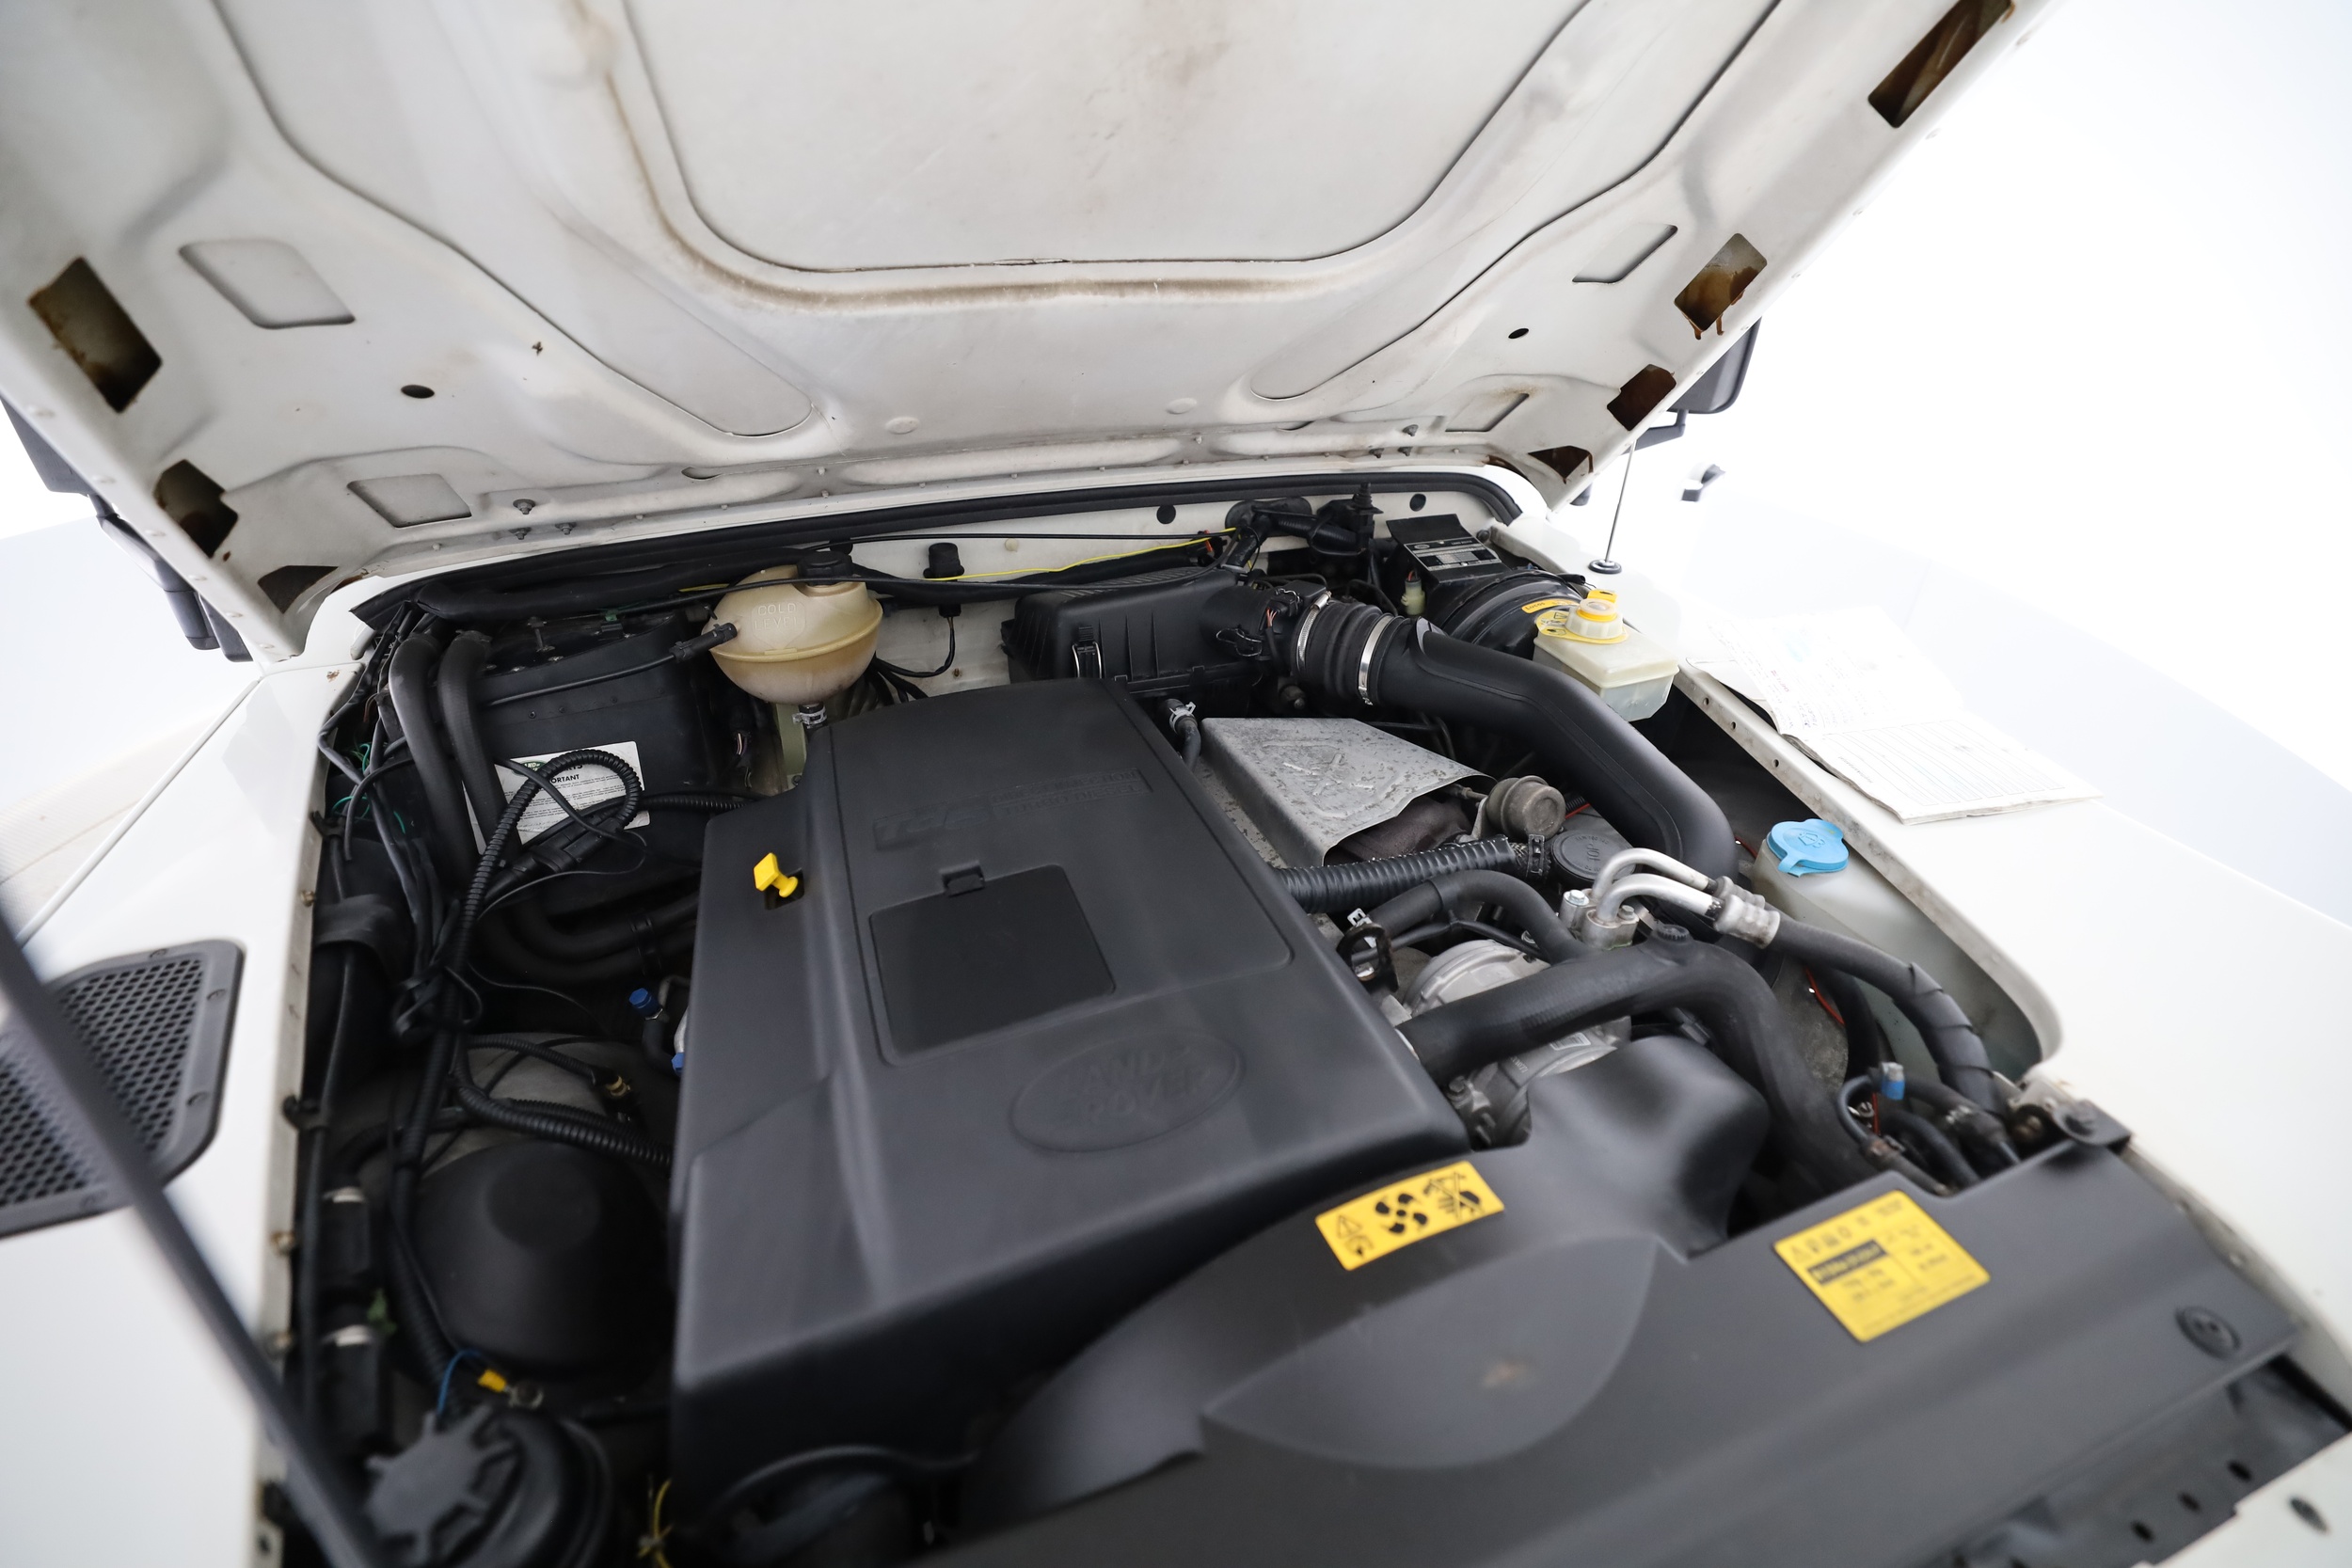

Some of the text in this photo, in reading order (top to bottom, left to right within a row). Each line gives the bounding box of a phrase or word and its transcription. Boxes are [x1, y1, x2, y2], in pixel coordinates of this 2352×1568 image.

[757, 602, 797, 616] COLD
[754, 616, 801, 631] LEVEL
[550, 774, 580, 784] ORTANT
